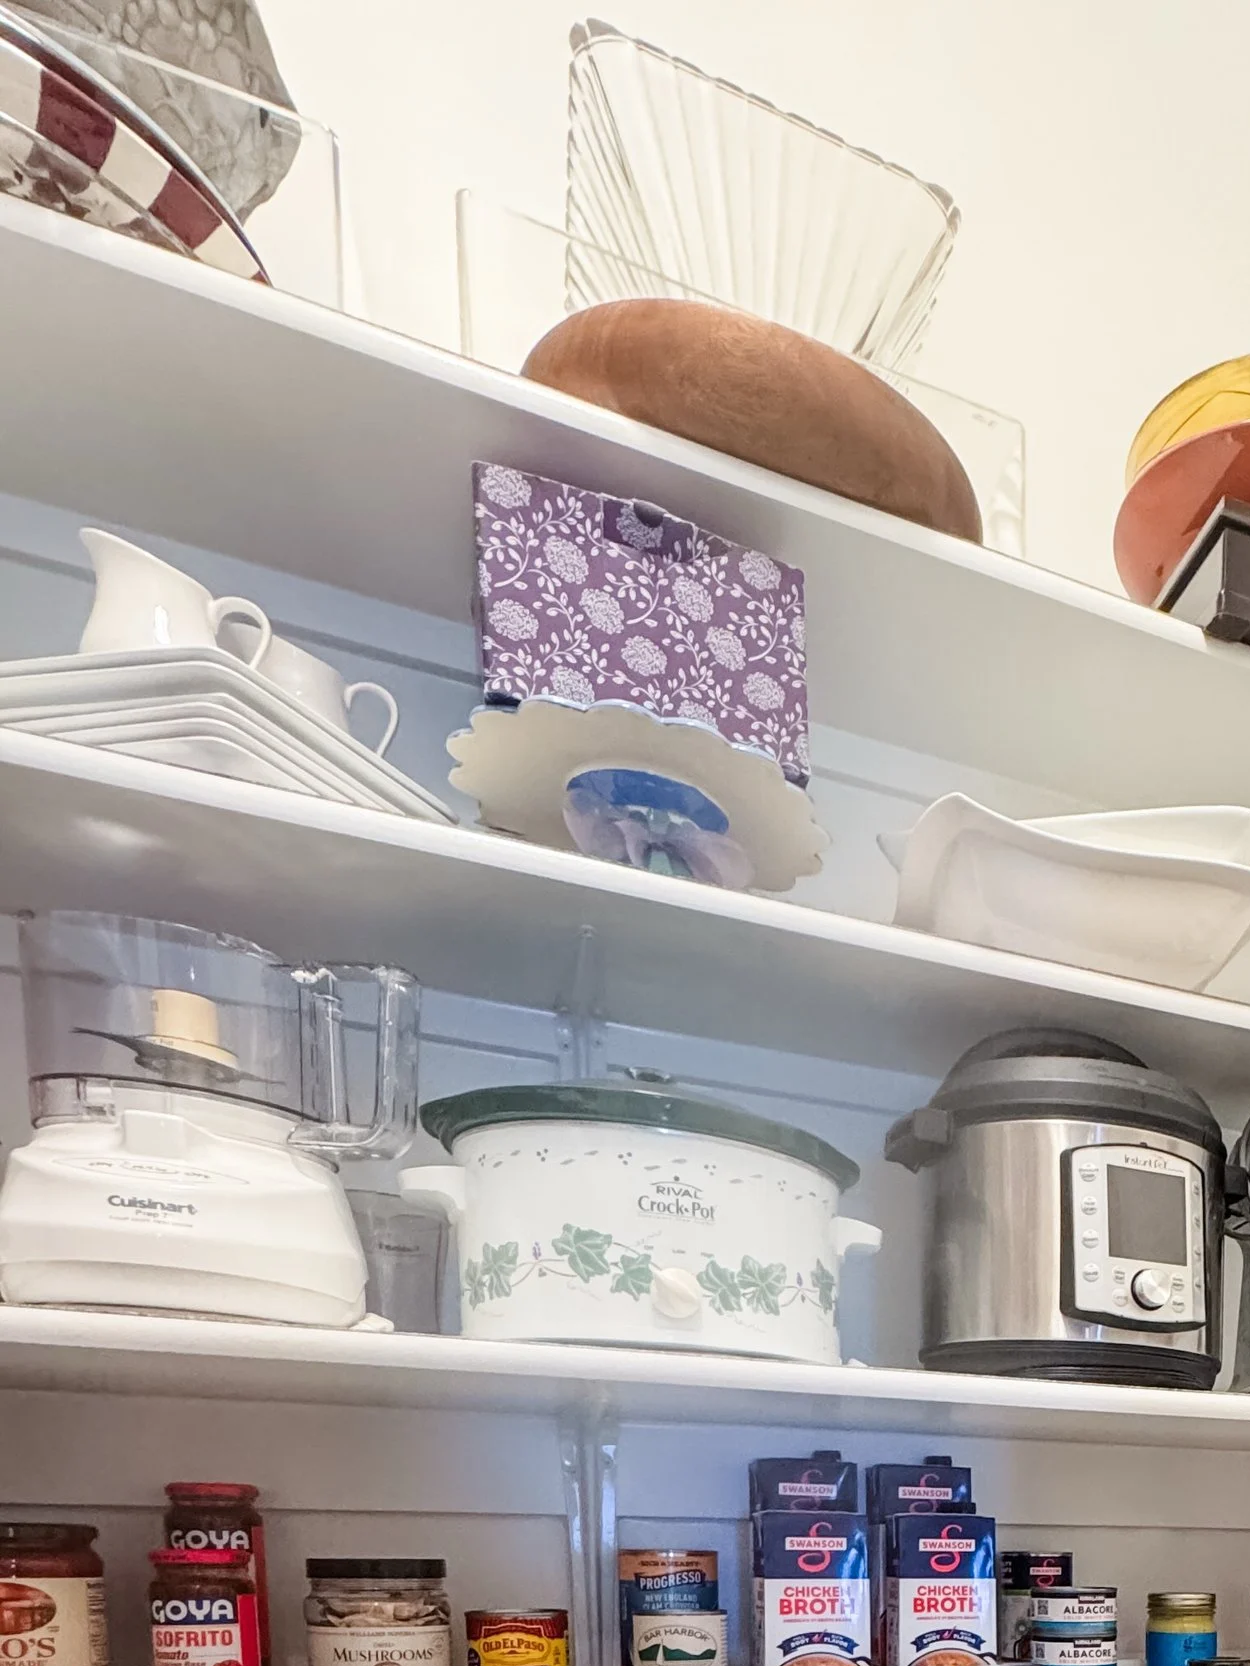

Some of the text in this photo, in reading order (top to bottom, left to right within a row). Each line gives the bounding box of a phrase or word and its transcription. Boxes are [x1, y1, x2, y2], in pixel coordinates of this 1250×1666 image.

[656, 1185, 703, 1201] RIVAL
[107, 1194, 198, 1215] Cuisinart
[781, 1484, 834, 1495] SWANSON
[901, 1488, 950, 1498] SWANSON
[170, 1529, 250, 1550] GOYA
[788, 1539, 843, 1549] SWANSON
[922, 1541, 972, 1550] SWANSON
[639, 1569, 702, 1591] PROGRESSO
[783, 1586, 852, 1597] CHICKEN
[916, 1585, 978, 1597] CHICKEN
[152, 1598, 235, 1621] GOYA
[779, 1599, 855, 1616] BROTH
[912, 1597, 982, 1614] BROTH
[1064, 1605, 1114, 1615] ALBACORE
[155, 1629, 234, 1648] SOFRITO
[644, 1630, 662, 1642] BAR
[0, 1637, 56, 1659] O'S
[482, 1638, 518, 1653] OLD EL
[333, 1647, 434, 1662] MUSHROOMS
[1059, 1648, 1112, 1659] ALBACORE
